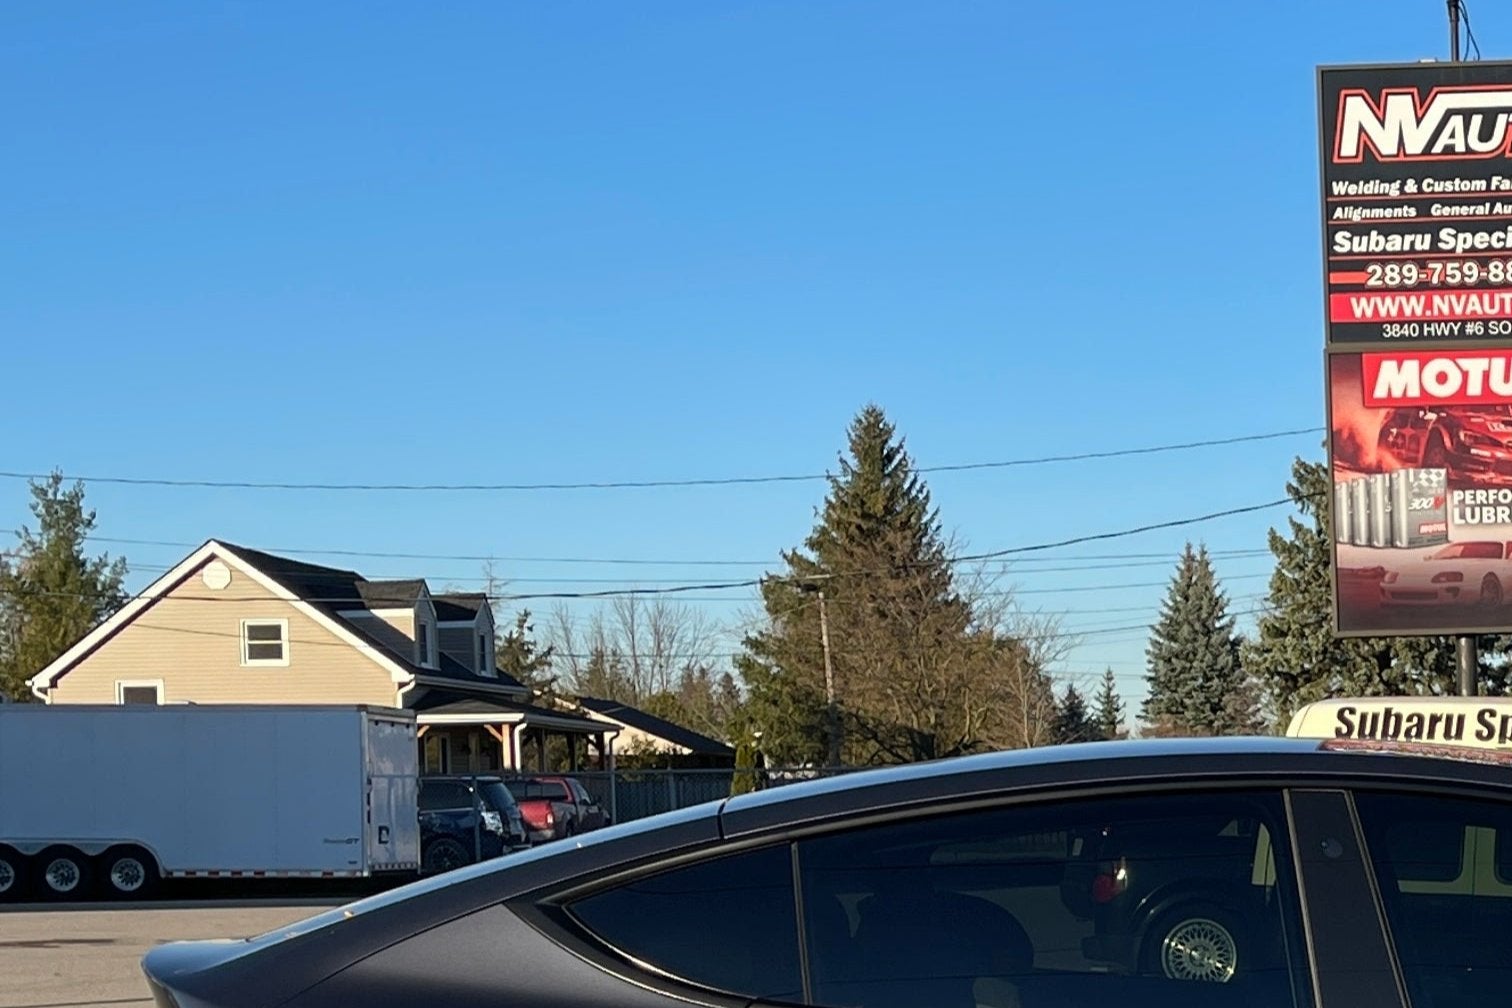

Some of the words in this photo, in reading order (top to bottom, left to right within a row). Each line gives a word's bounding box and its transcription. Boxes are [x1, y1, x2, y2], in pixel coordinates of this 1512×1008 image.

[1332, 180, 1401, 196] Welding
[1405, 179, 1418, 193] &
[1422, 177, 1487, 193] Custom
[1333, 205, 1417, 221] Alignments
[1431, 203, 1489, 216] General
[1333, 230, 1431, 253] Subaru
[1382, 323, 1419, 338] 3840
[1423, 321, 1460, 336] HWY
[1465, 321, 1483, 335] #6
[1334, 706, 1466, 741] Subaru
